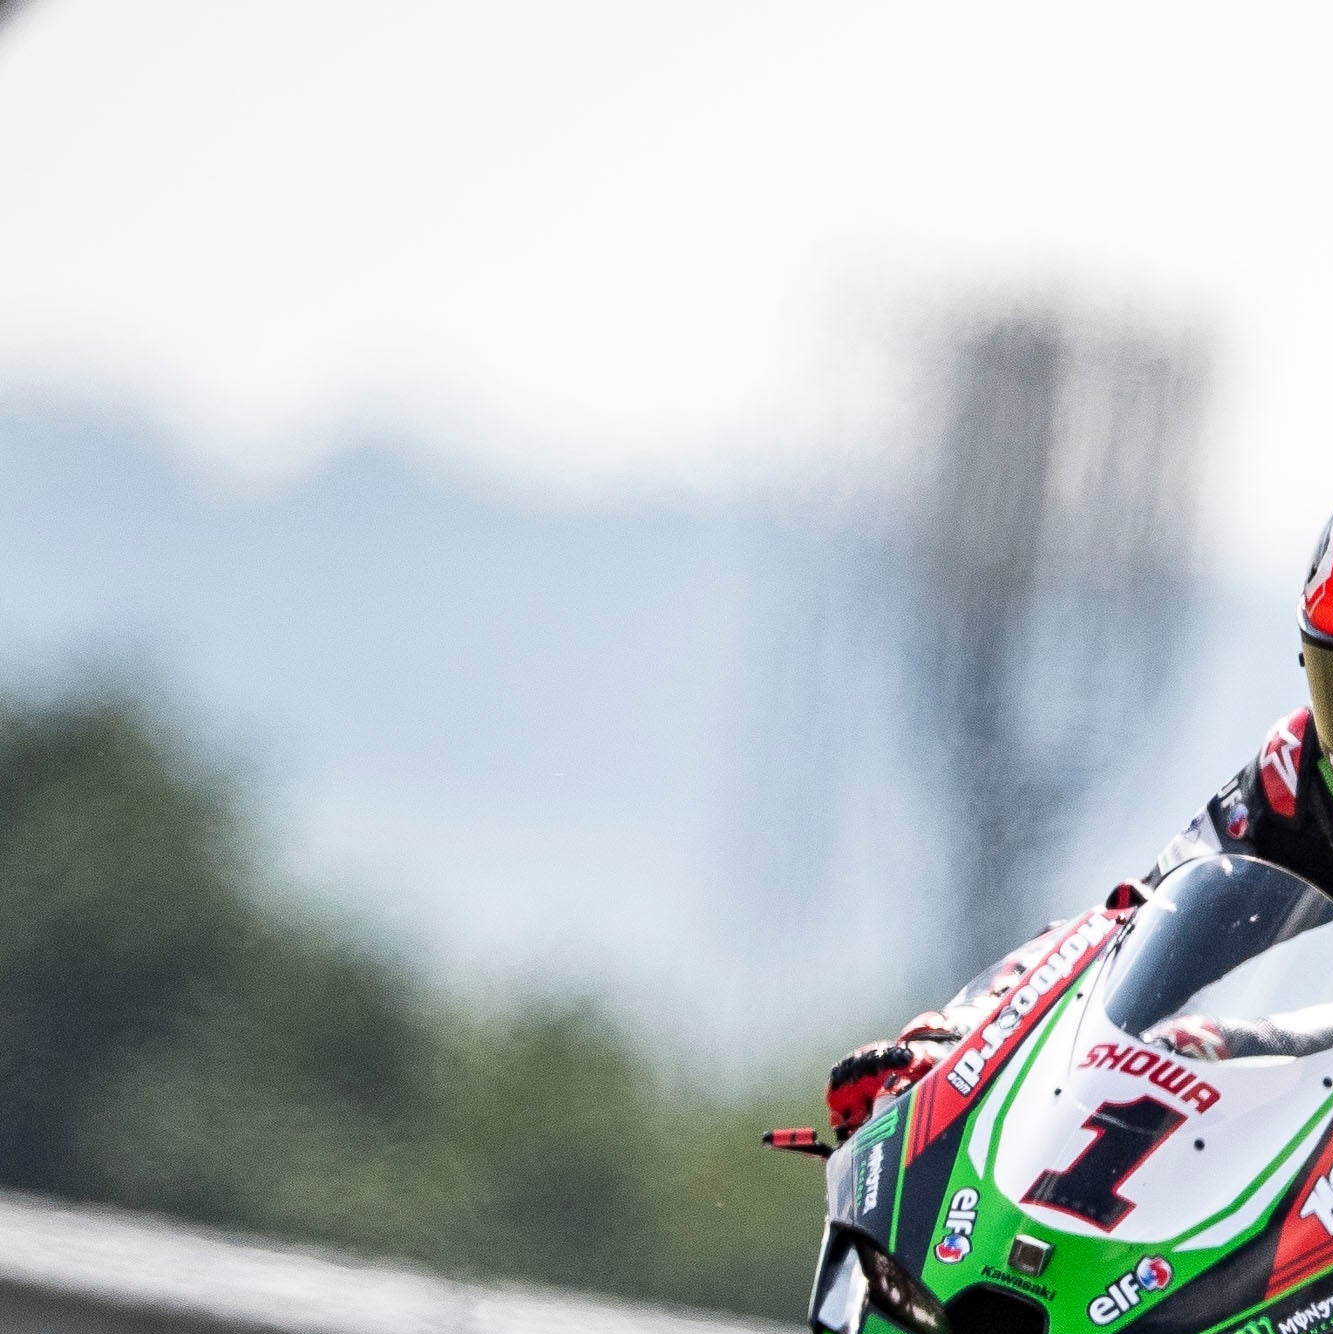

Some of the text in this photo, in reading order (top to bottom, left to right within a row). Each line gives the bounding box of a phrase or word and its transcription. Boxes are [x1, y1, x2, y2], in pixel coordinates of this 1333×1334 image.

[1077, 1042, 1222, 1115] SHOWA
[1019, 1093, 1189, 1234] 1
[944, 1187, 979, 1237] elf
[980, 1264, 1057, 1302] Kawasaki
[1088, 1272, 1143, 1326] elf
